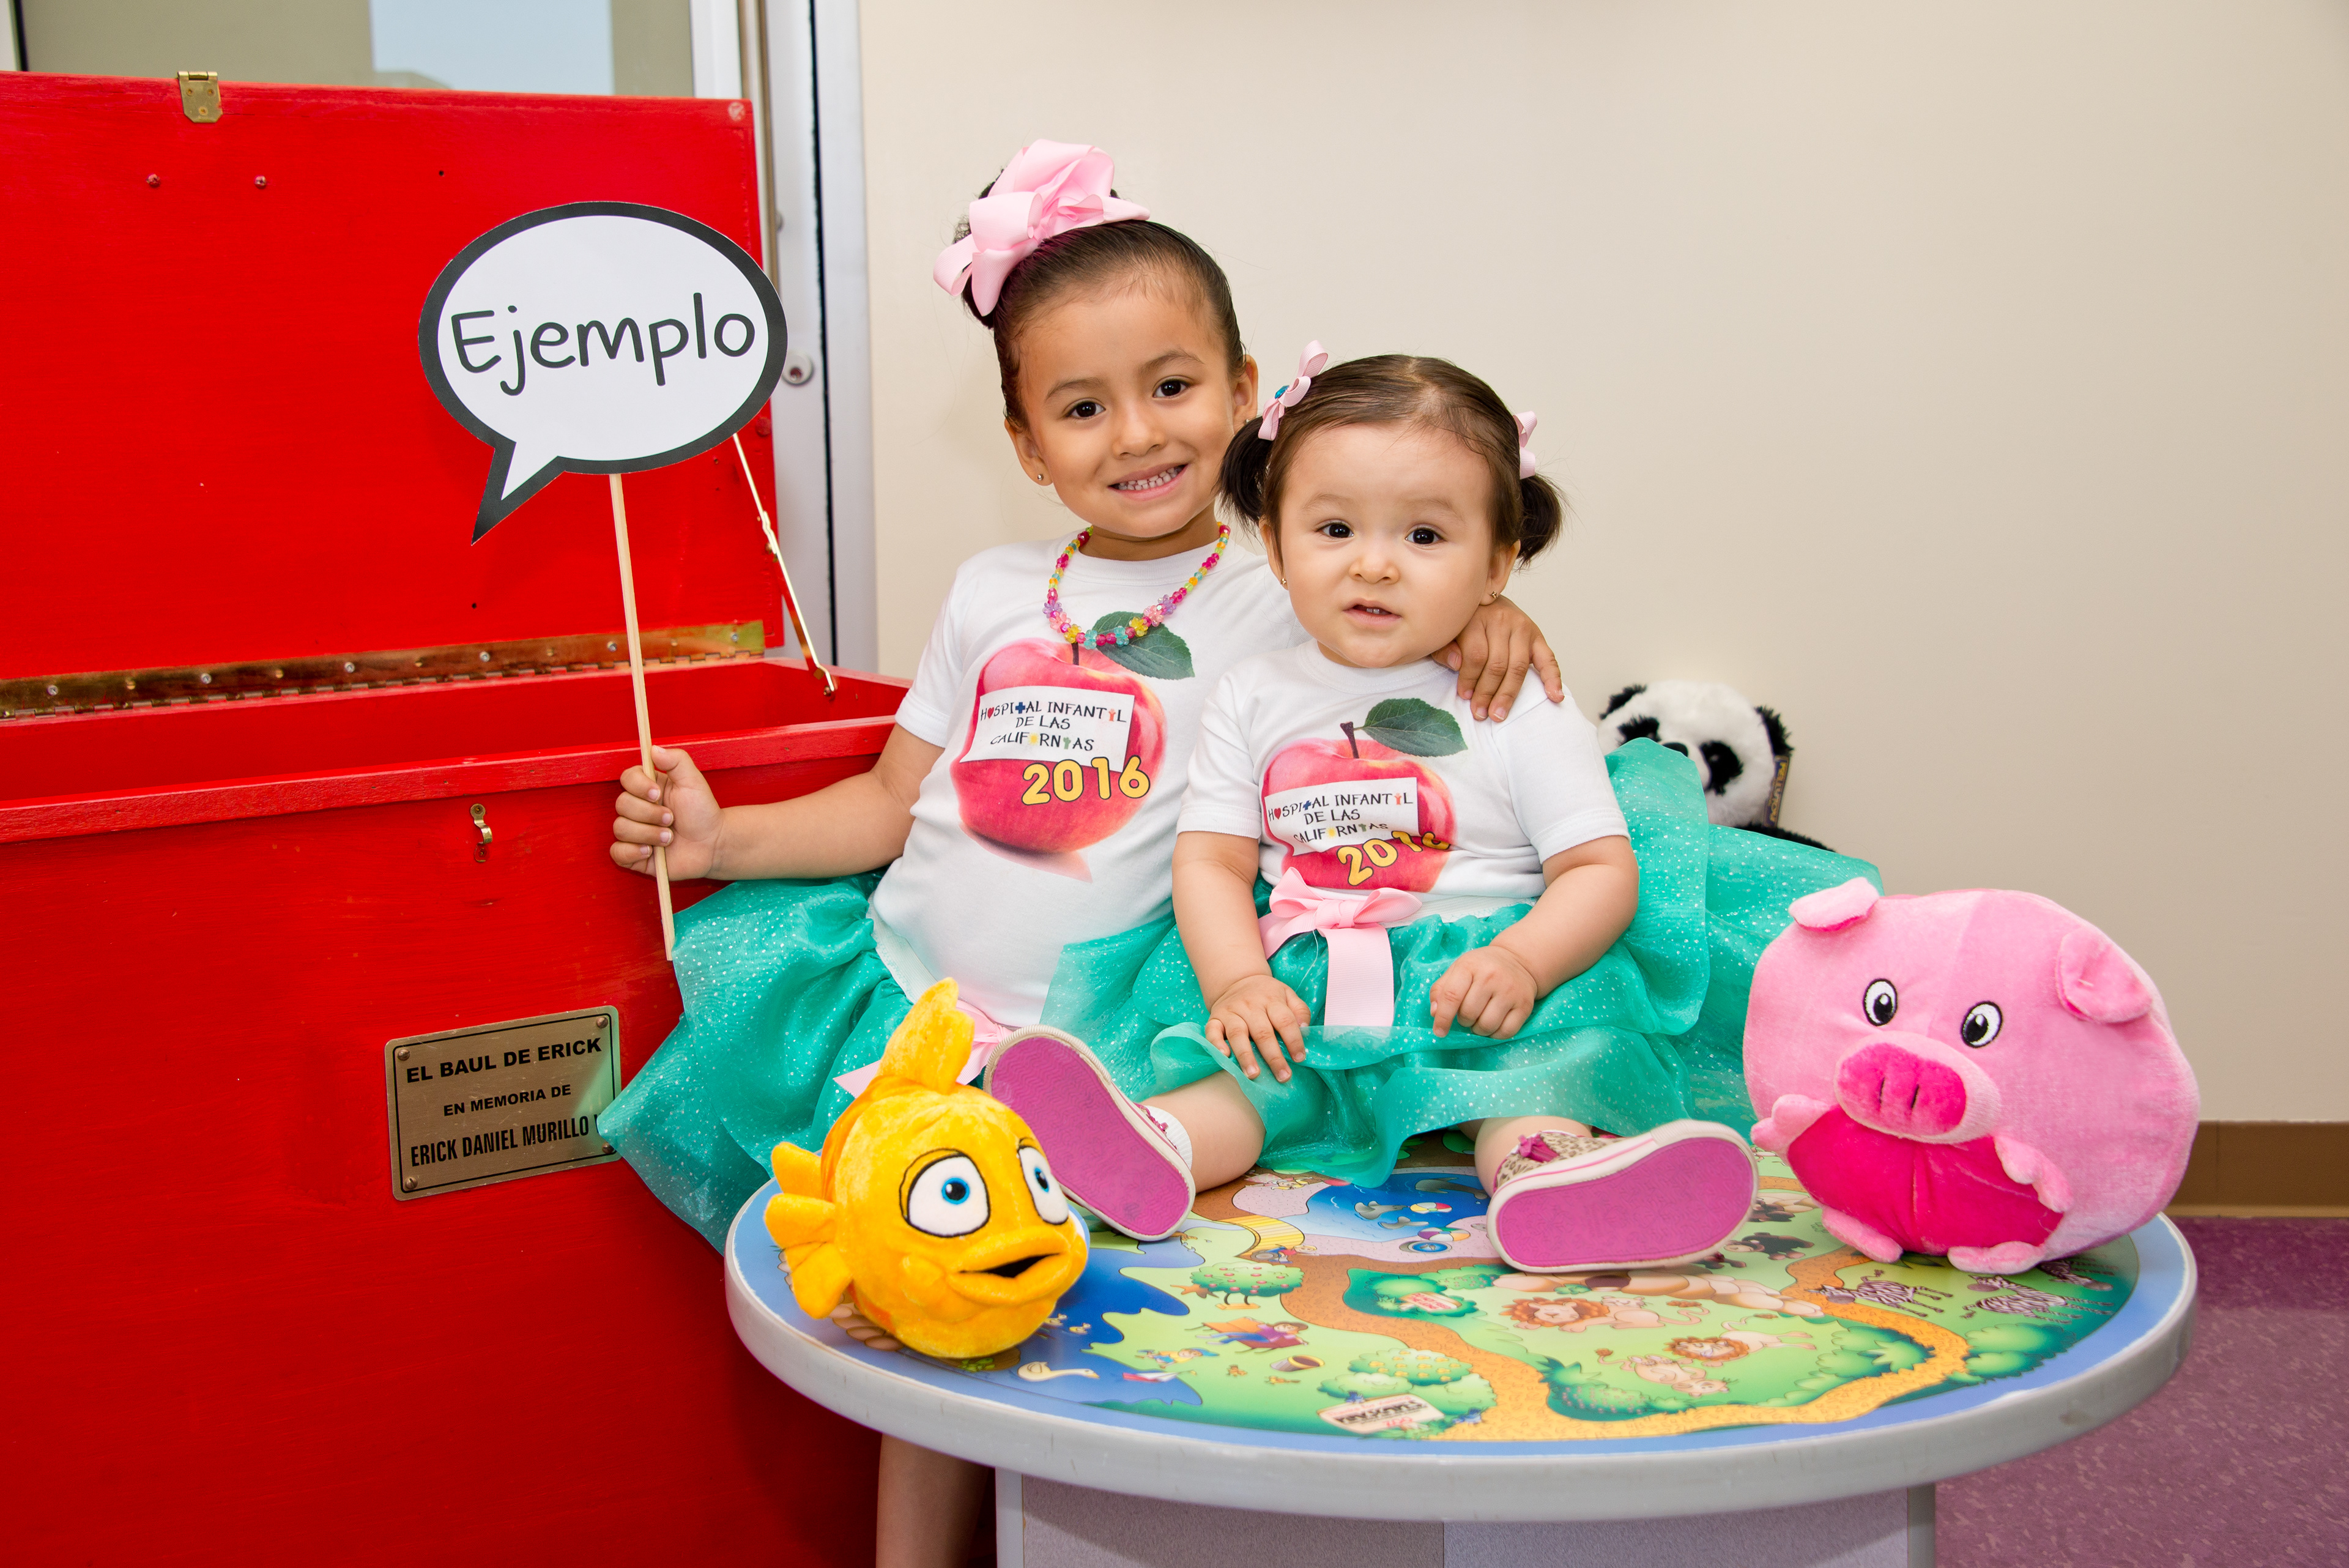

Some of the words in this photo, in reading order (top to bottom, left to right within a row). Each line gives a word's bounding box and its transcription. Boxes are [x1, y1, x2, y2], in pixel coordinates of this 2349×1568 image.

[451, 292, 755, 396] Ejemplo
[1015, 716, 1034, 728] DE
[1039, 715, 1071, 730] LAS
[1022, 754, 1151, 806] 2016
[1304, 811, 1326, 825] DE
[1330, 809, 1361, 822] LAS
[406, 1065, 434, 1083] EL
[440, 1055, 497, 1078] BAUL
[503, 1049, 531, 1067] DE
[538, 1038, 603, 1061] ERICK
[443, 1101, 466, 1117] EN
[470, 1088, 546, 1112] MEMORIA
[551, 1084, 572, 1099] DE
[410, 1139, 458, 1167] ERICK
[462, 1128, 518, 1157] DANIEL
[522, 1115, 589, 1147] MURILLO
